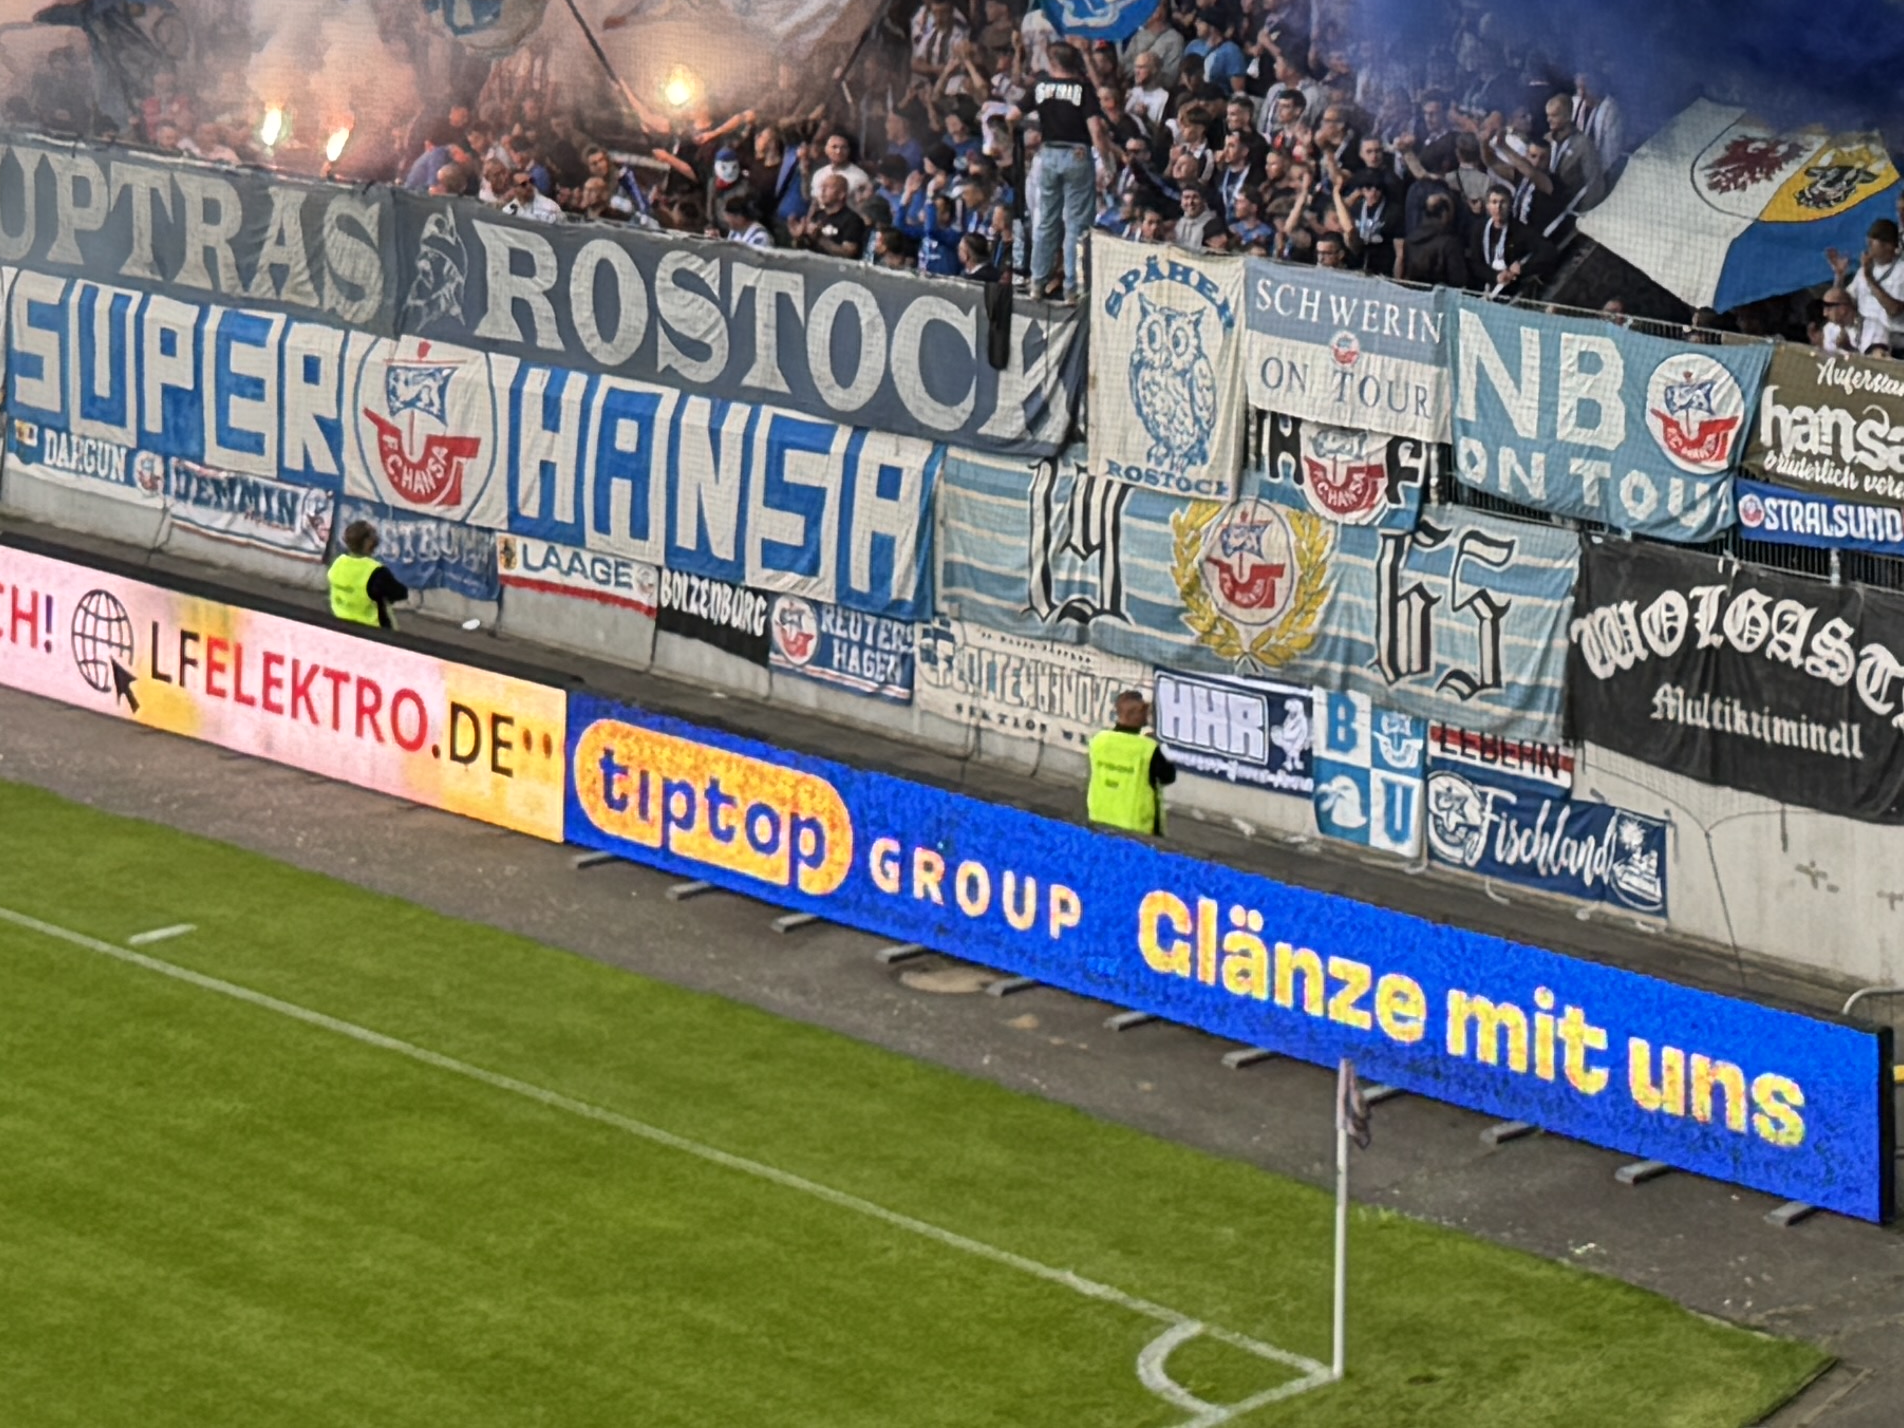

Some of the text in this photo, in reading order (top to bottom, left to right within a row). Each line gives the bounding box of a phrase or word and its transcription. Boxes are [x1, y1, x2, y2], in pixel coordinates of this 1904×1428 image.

[472, 218, 1088, 453] ROSTOCK
[1256, 278, 1444, 344] SCHWERIN
[1261, 357, 1432, 420] ON TOUR
[1456, 308, 1626, 451] NB
[13, 269, 938, 608] SUPER HANSA
[42, 428, 128, 484] DARGUN
[1456, 436, 1546, 501] ON
[521, 541, 634, 591] LAAGE
[1765, 496, 1902, 544] STRALSUND
[150, 620, 515, 778] LFELEKTRO.DE
[1157, 676, 1266, 760] HHR
[1650, 682, 1864, 760] Multikriminell
[599, 747, 829, 871] tiptop
[1462, 784, 1619, 887] Fischland
[868, 836, 1082, 940] GROUP
[1136, 889, 1806, 1147] Glänze mit uns
